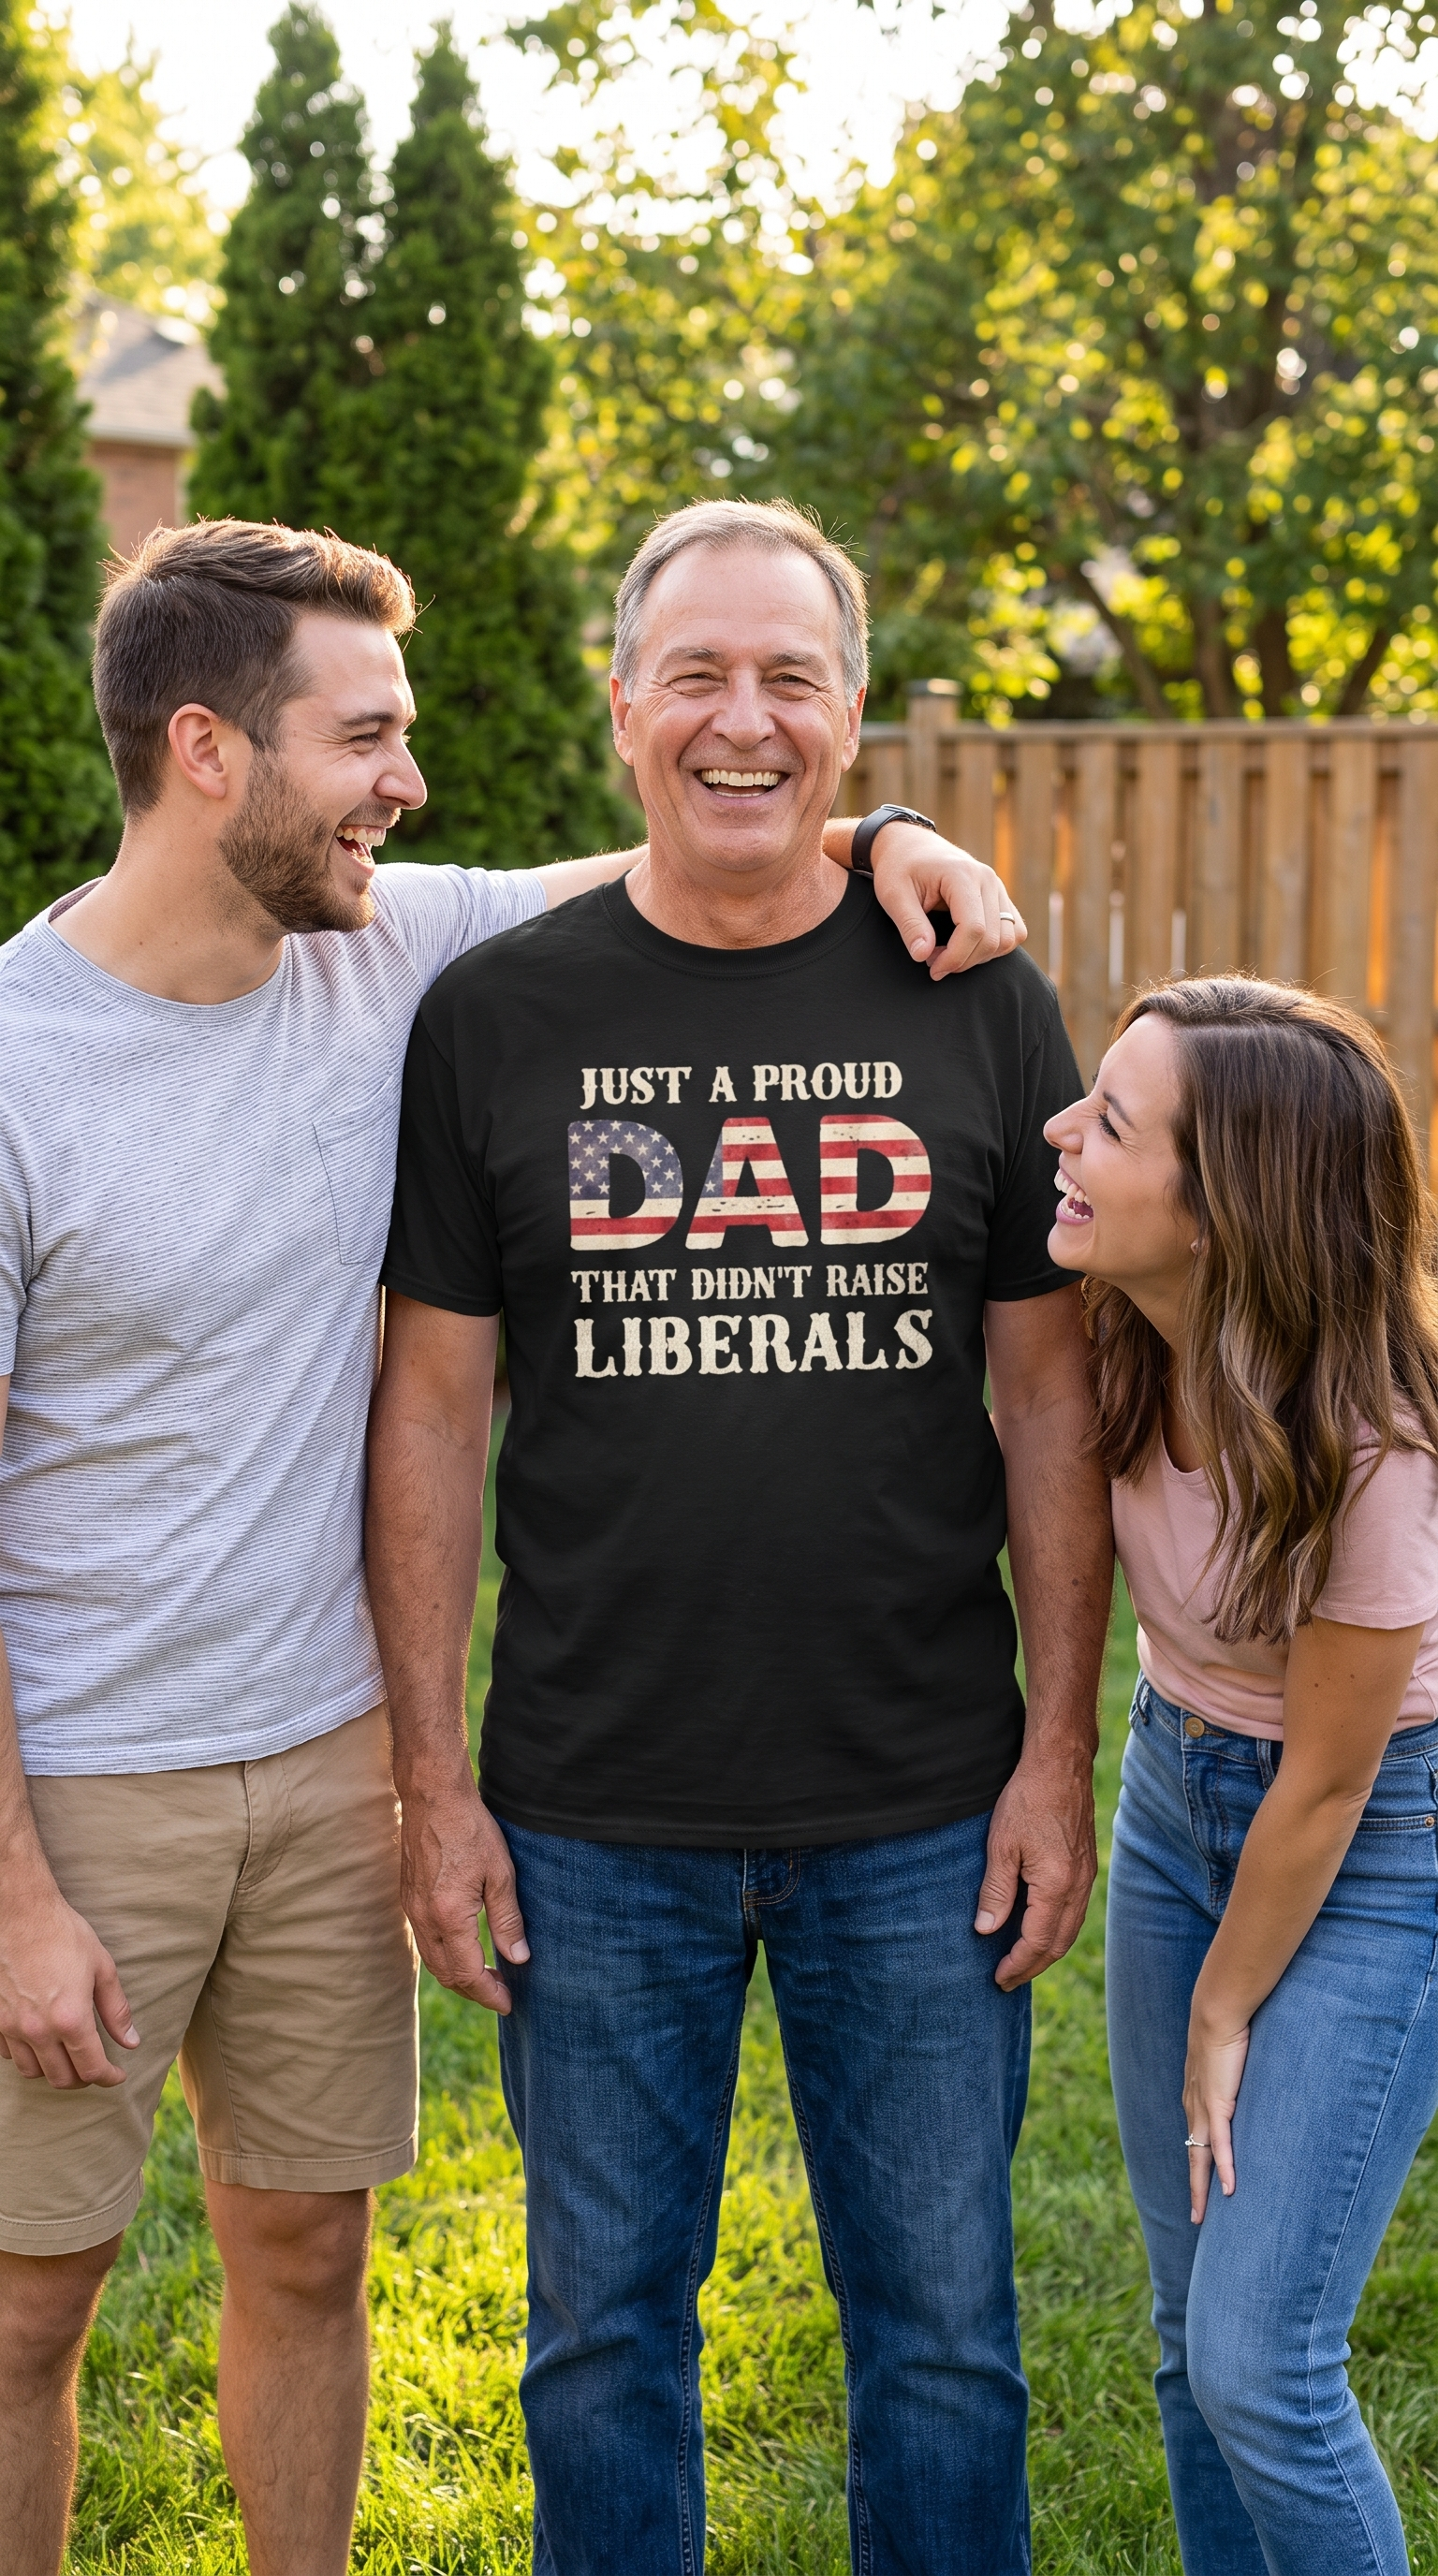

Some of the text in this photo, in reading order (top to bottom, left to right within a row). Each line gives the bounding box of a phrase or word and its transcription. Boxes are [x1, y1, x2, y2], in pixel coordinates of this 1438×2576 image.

[580, 1061, 902, 1109] JUST A PROUD
[567, 1114, 932, 1251] DAD
[570, 1262, 929, 1302] THAT DIDN'T RAISE
[573, 1309, 933, 1379] LIBERALS
